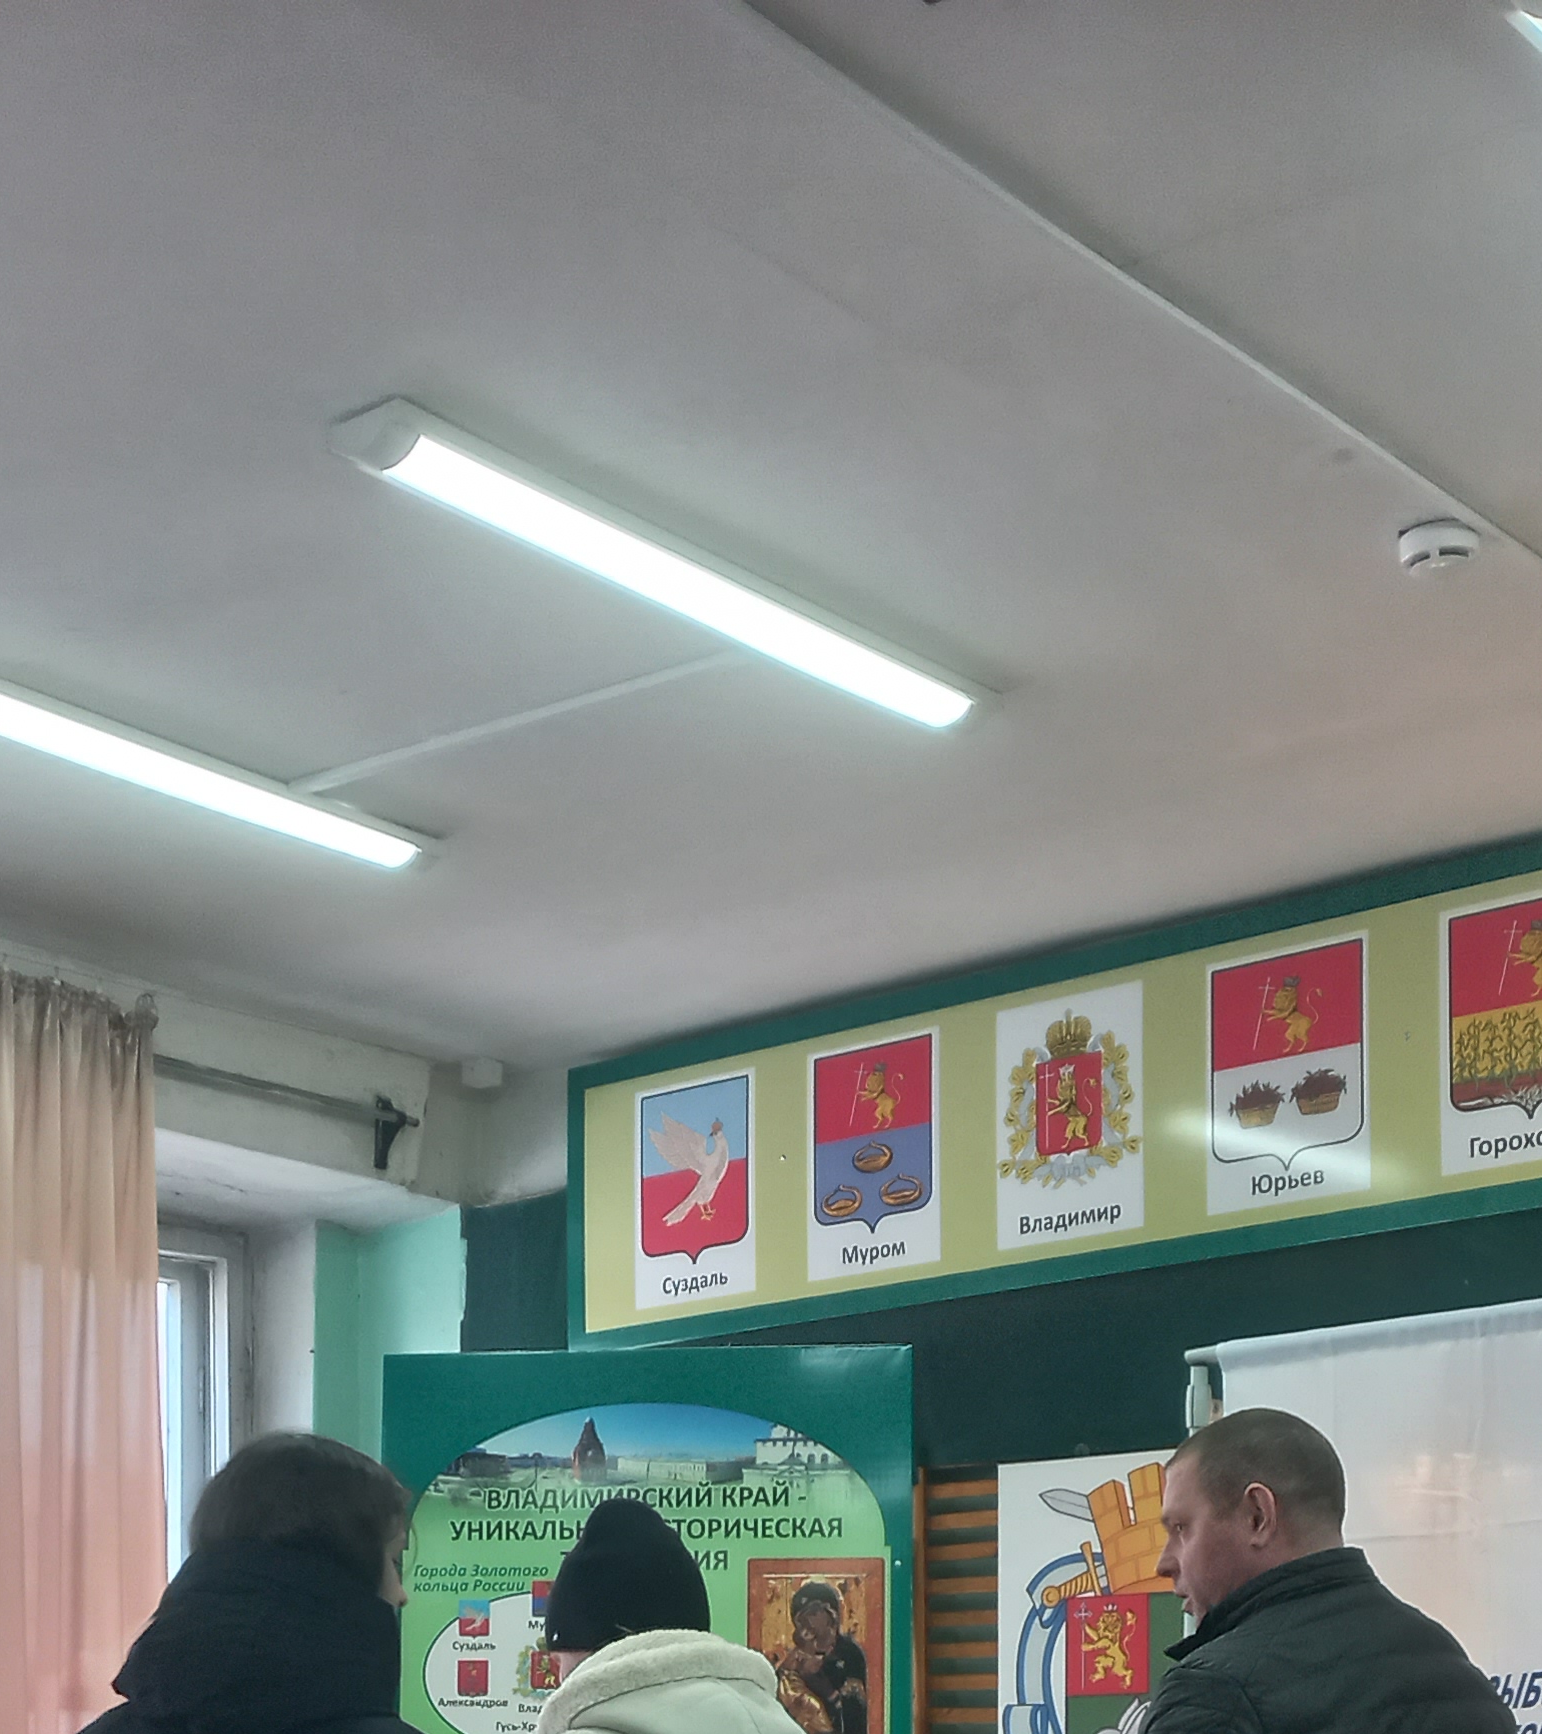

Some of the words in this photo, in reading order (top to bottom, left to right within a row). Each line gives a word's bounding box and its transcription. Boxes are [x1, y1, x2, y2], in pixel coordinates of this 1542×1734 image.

[1250, 1164, 1326, 1198] Юрьев
[1018, 1198, 1122, 1236] Владимир
[840, 1237, 907, 1267] Муром
[661, 1267, 729, 1299] Суздаль
[722, 1480, 790, 1508] КРАЙ
[414, 1563, 467, 1580] Города
[470, 1564, 549, 1578] Золотого
[414, 1581, 468, 1594] кольца
[473, 1579, 525, 1592] России
[452, 1641, 496, 1653] Суздаль
[438, 1699, 508, 1709] Александров
